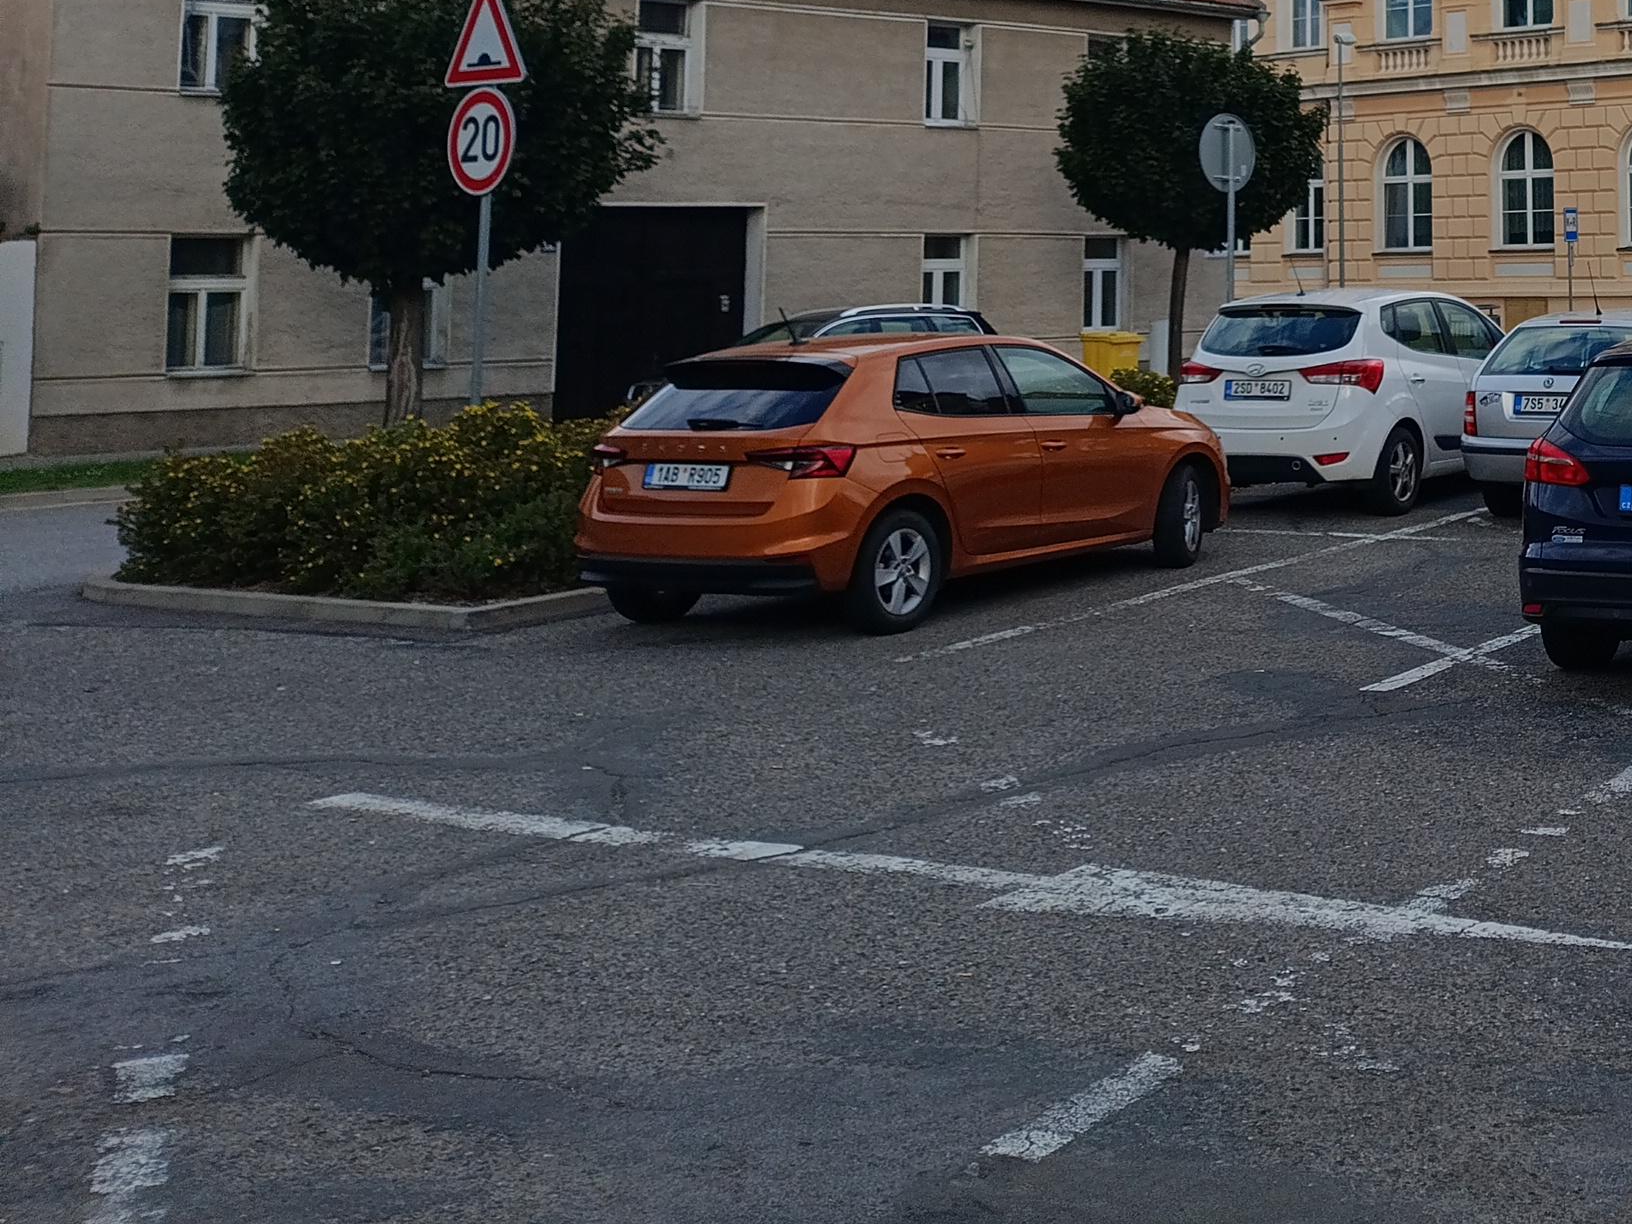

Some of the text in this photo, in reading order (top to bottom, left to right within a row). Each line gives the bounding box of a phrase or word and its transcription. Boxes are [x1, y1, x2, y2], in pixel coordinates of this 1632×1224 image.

[461, 114, 500, 163] 20
[1260, 382, 1285, 395] 8402
[657, 465, 723, 484] 1AB R905
